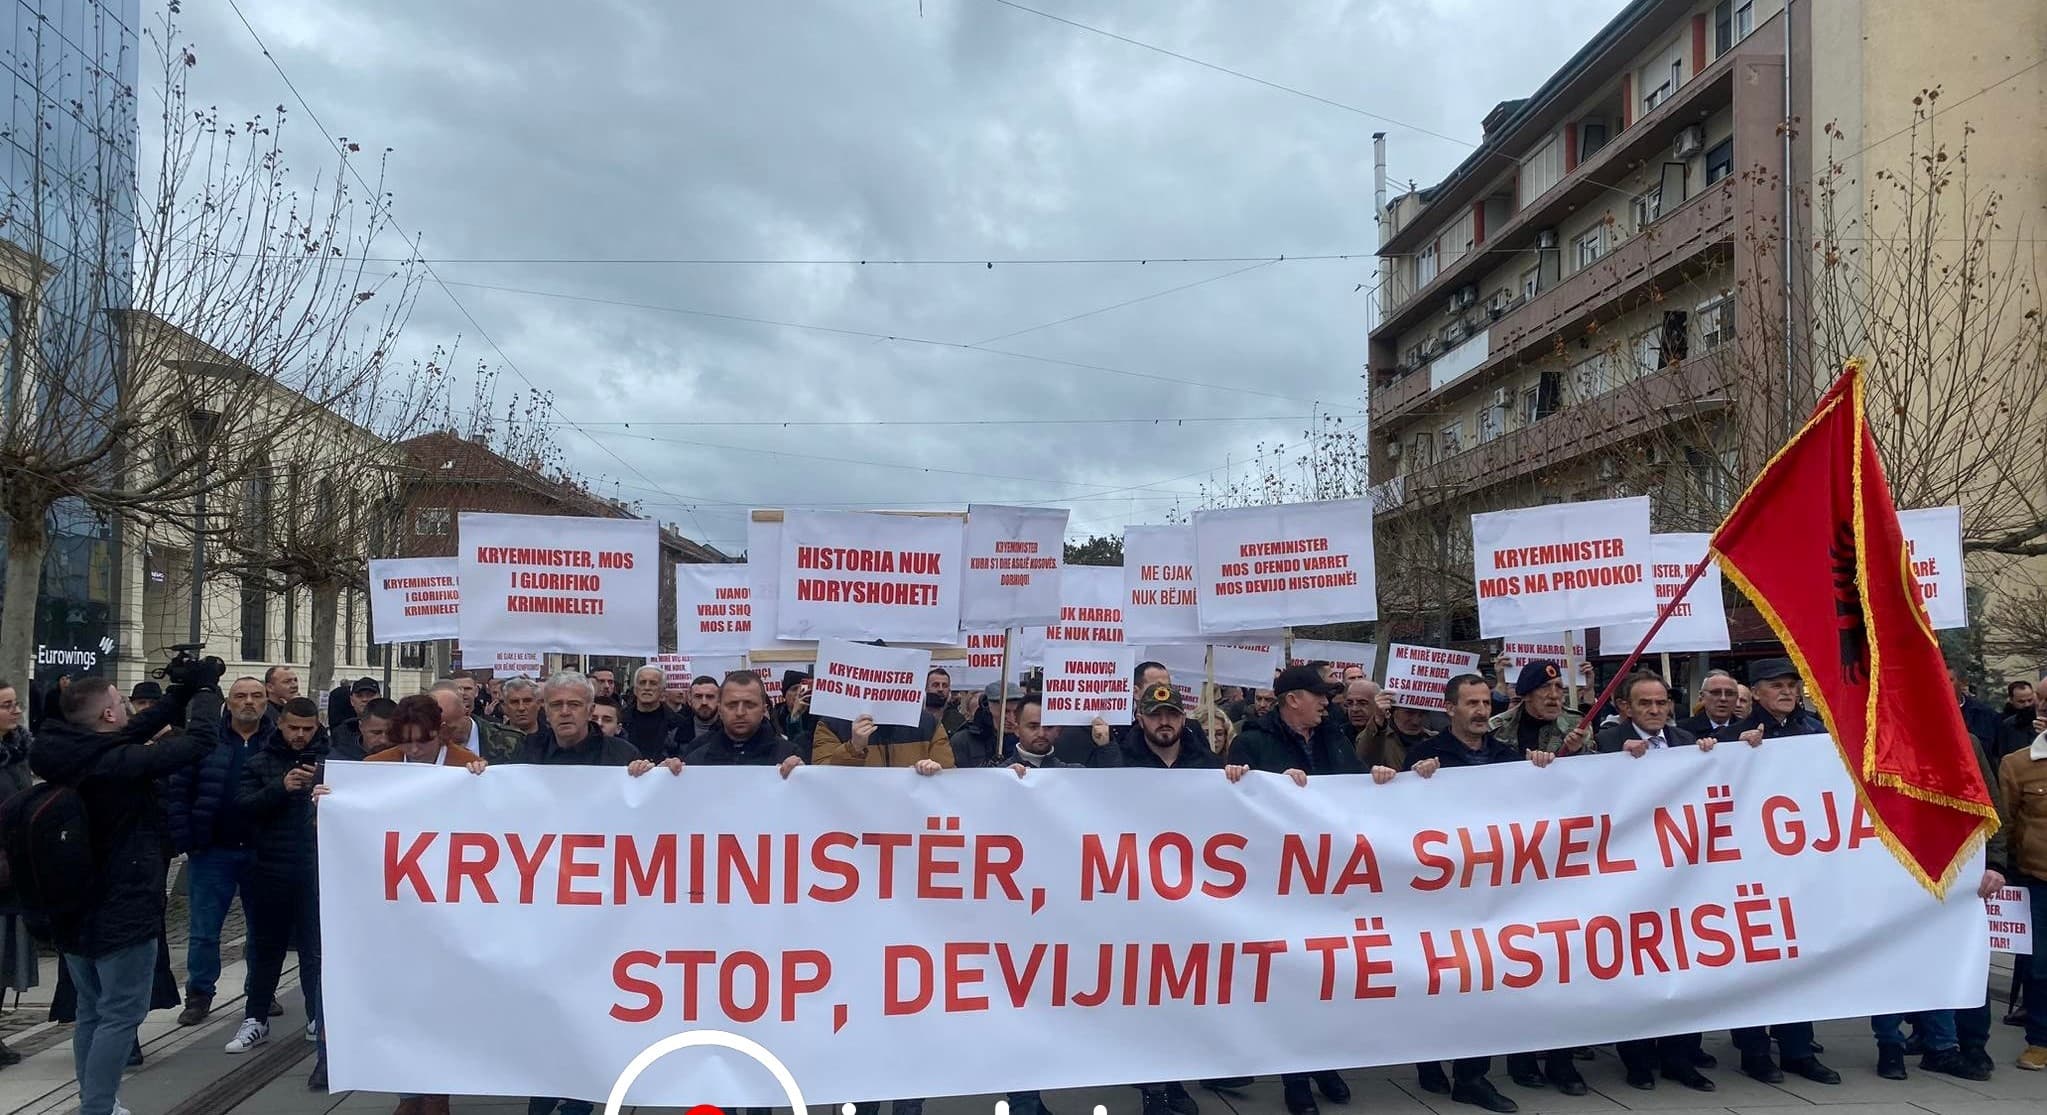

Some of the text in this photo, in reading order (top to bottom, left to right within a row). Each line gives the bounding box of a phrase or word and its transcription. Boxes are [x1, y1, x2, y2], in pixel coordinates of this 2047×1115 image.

[478, 547, 634, 569] KRYEMINISTER, MOS
[1240, 538, 1329, 558] KRYEMINISTER
[1494, 538, 1624, 569] KRYEMINISTER
[797, 546, 941, 575] HISTORIA NUK
[1222, 554, 1349, 577] MOS OFENDO VARRET
[511, 572, 600, 591] I GLORIFIKO
[1141, 565, 1193, 581] ME GJAK
[1215, 570, 1357, 596] MOS DEVIJO HISTORINË!
[1479, 563, 1642, 598] MOS NA PROVOKO!
[411, 590, 459, 602] GLORIFIKO
[797, 578, 938, 606] NDRYSHOHET!
[1132, 589, 1157, 605] NUK
[404, 604, 459, 616] KRIMINELET
[507, 595, 604, 615] KRIMINELET!
[697, 604, 726, 616] VRAU
[700, 620, 725, 632] MOS
[727, 620, 733, 632] E
[1046, 626, 1061, 640] NE
[1064, 627, 1090, 640] NUK
[38, 645, 96, 670] Eurowings
[1506, 643, 1516, 653] NE
[1518, 643, 1535, 654] NUK
[1447, 654, 1470, 666] ALBIN
[829, 662, 914, 684] KRYEMINISTER
[816, 678, 921, 703] MOS NA PROVOKO!
[1046, 677, 1130, 694] VRAU SHQIPTARË.
[1389, 678, 1399, 689] SE
[1400, 679, 1411, 690] SA
[1047, 697, 1072, 711] MOS
[1074, 697, 1081, 711] E
[384, 816, 1046, 915] KRYEMINISTËR,
[1081, 832, 1248, 901] MOS
[1278, 834, 1383, 896] NA
[1410, 815, 1638, 891] SHKEL
[1654, 786, 1742, 868] NË
[609, 883, 1799, 1034] STOP, DEVIJIMIT TË HISTORISË!
